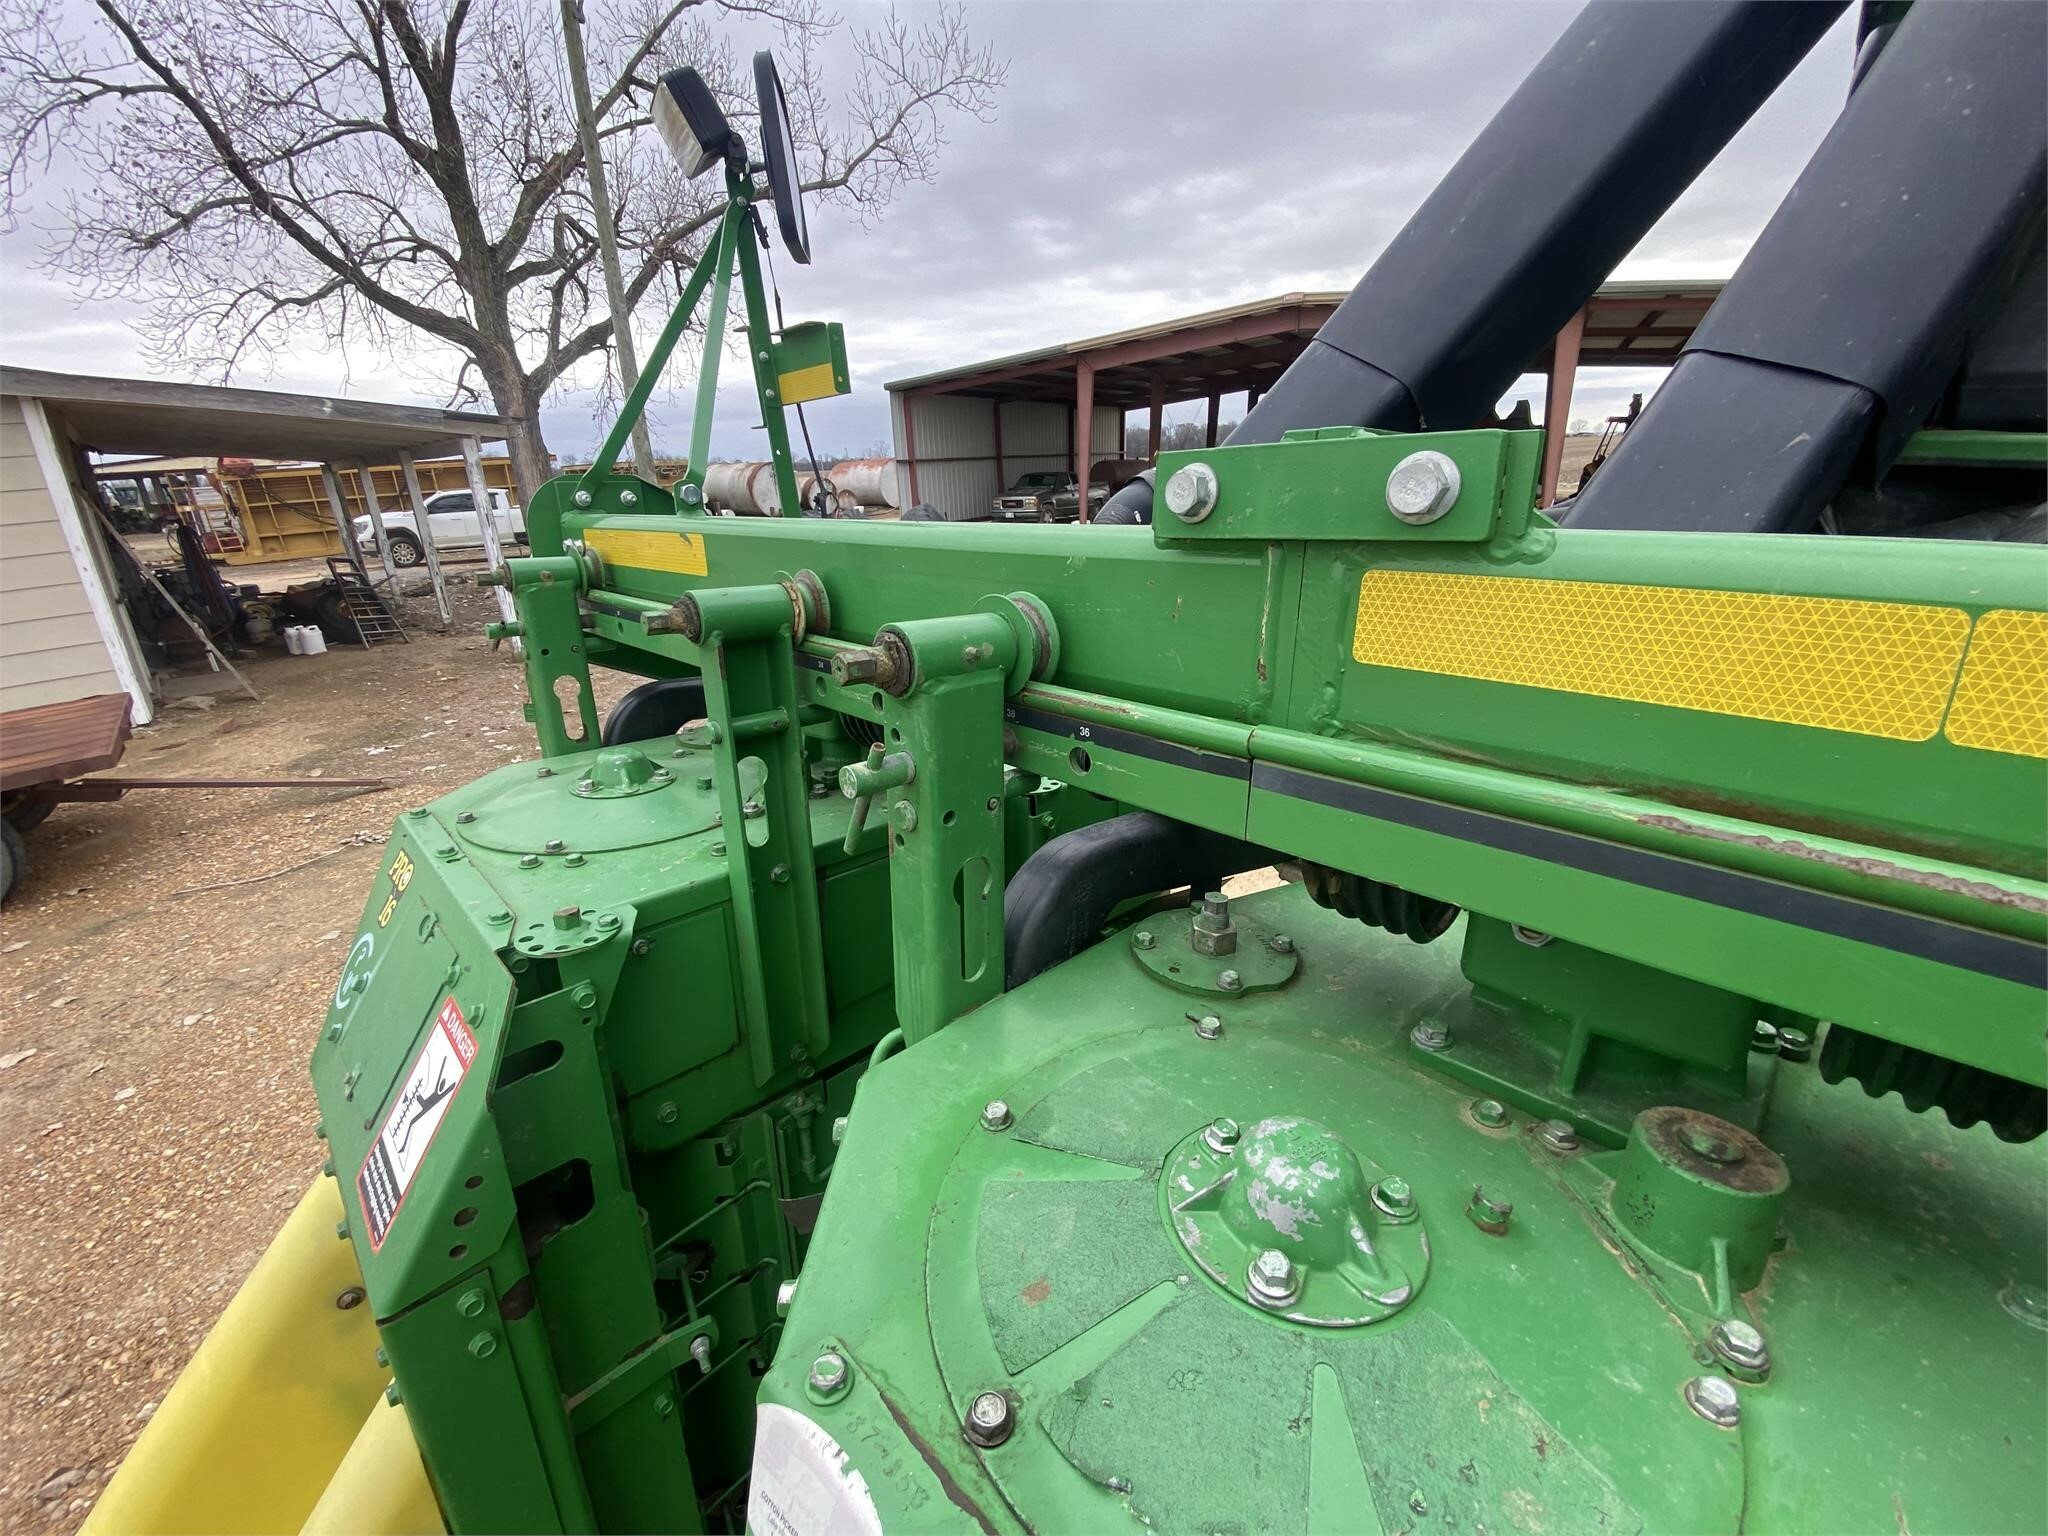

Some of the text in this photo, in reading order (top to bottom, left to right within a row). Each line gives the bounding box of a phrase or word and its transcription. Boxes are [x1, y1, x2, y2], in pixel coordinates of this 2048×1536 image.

[1079, 726, 1090, 737] 36
[388, 849, 414, 892] PRO
[378, 894, 397, 928] 16
[446, 1011, 476, 1066] DANGER
[761, 1490, 780, 1518] COTTON
